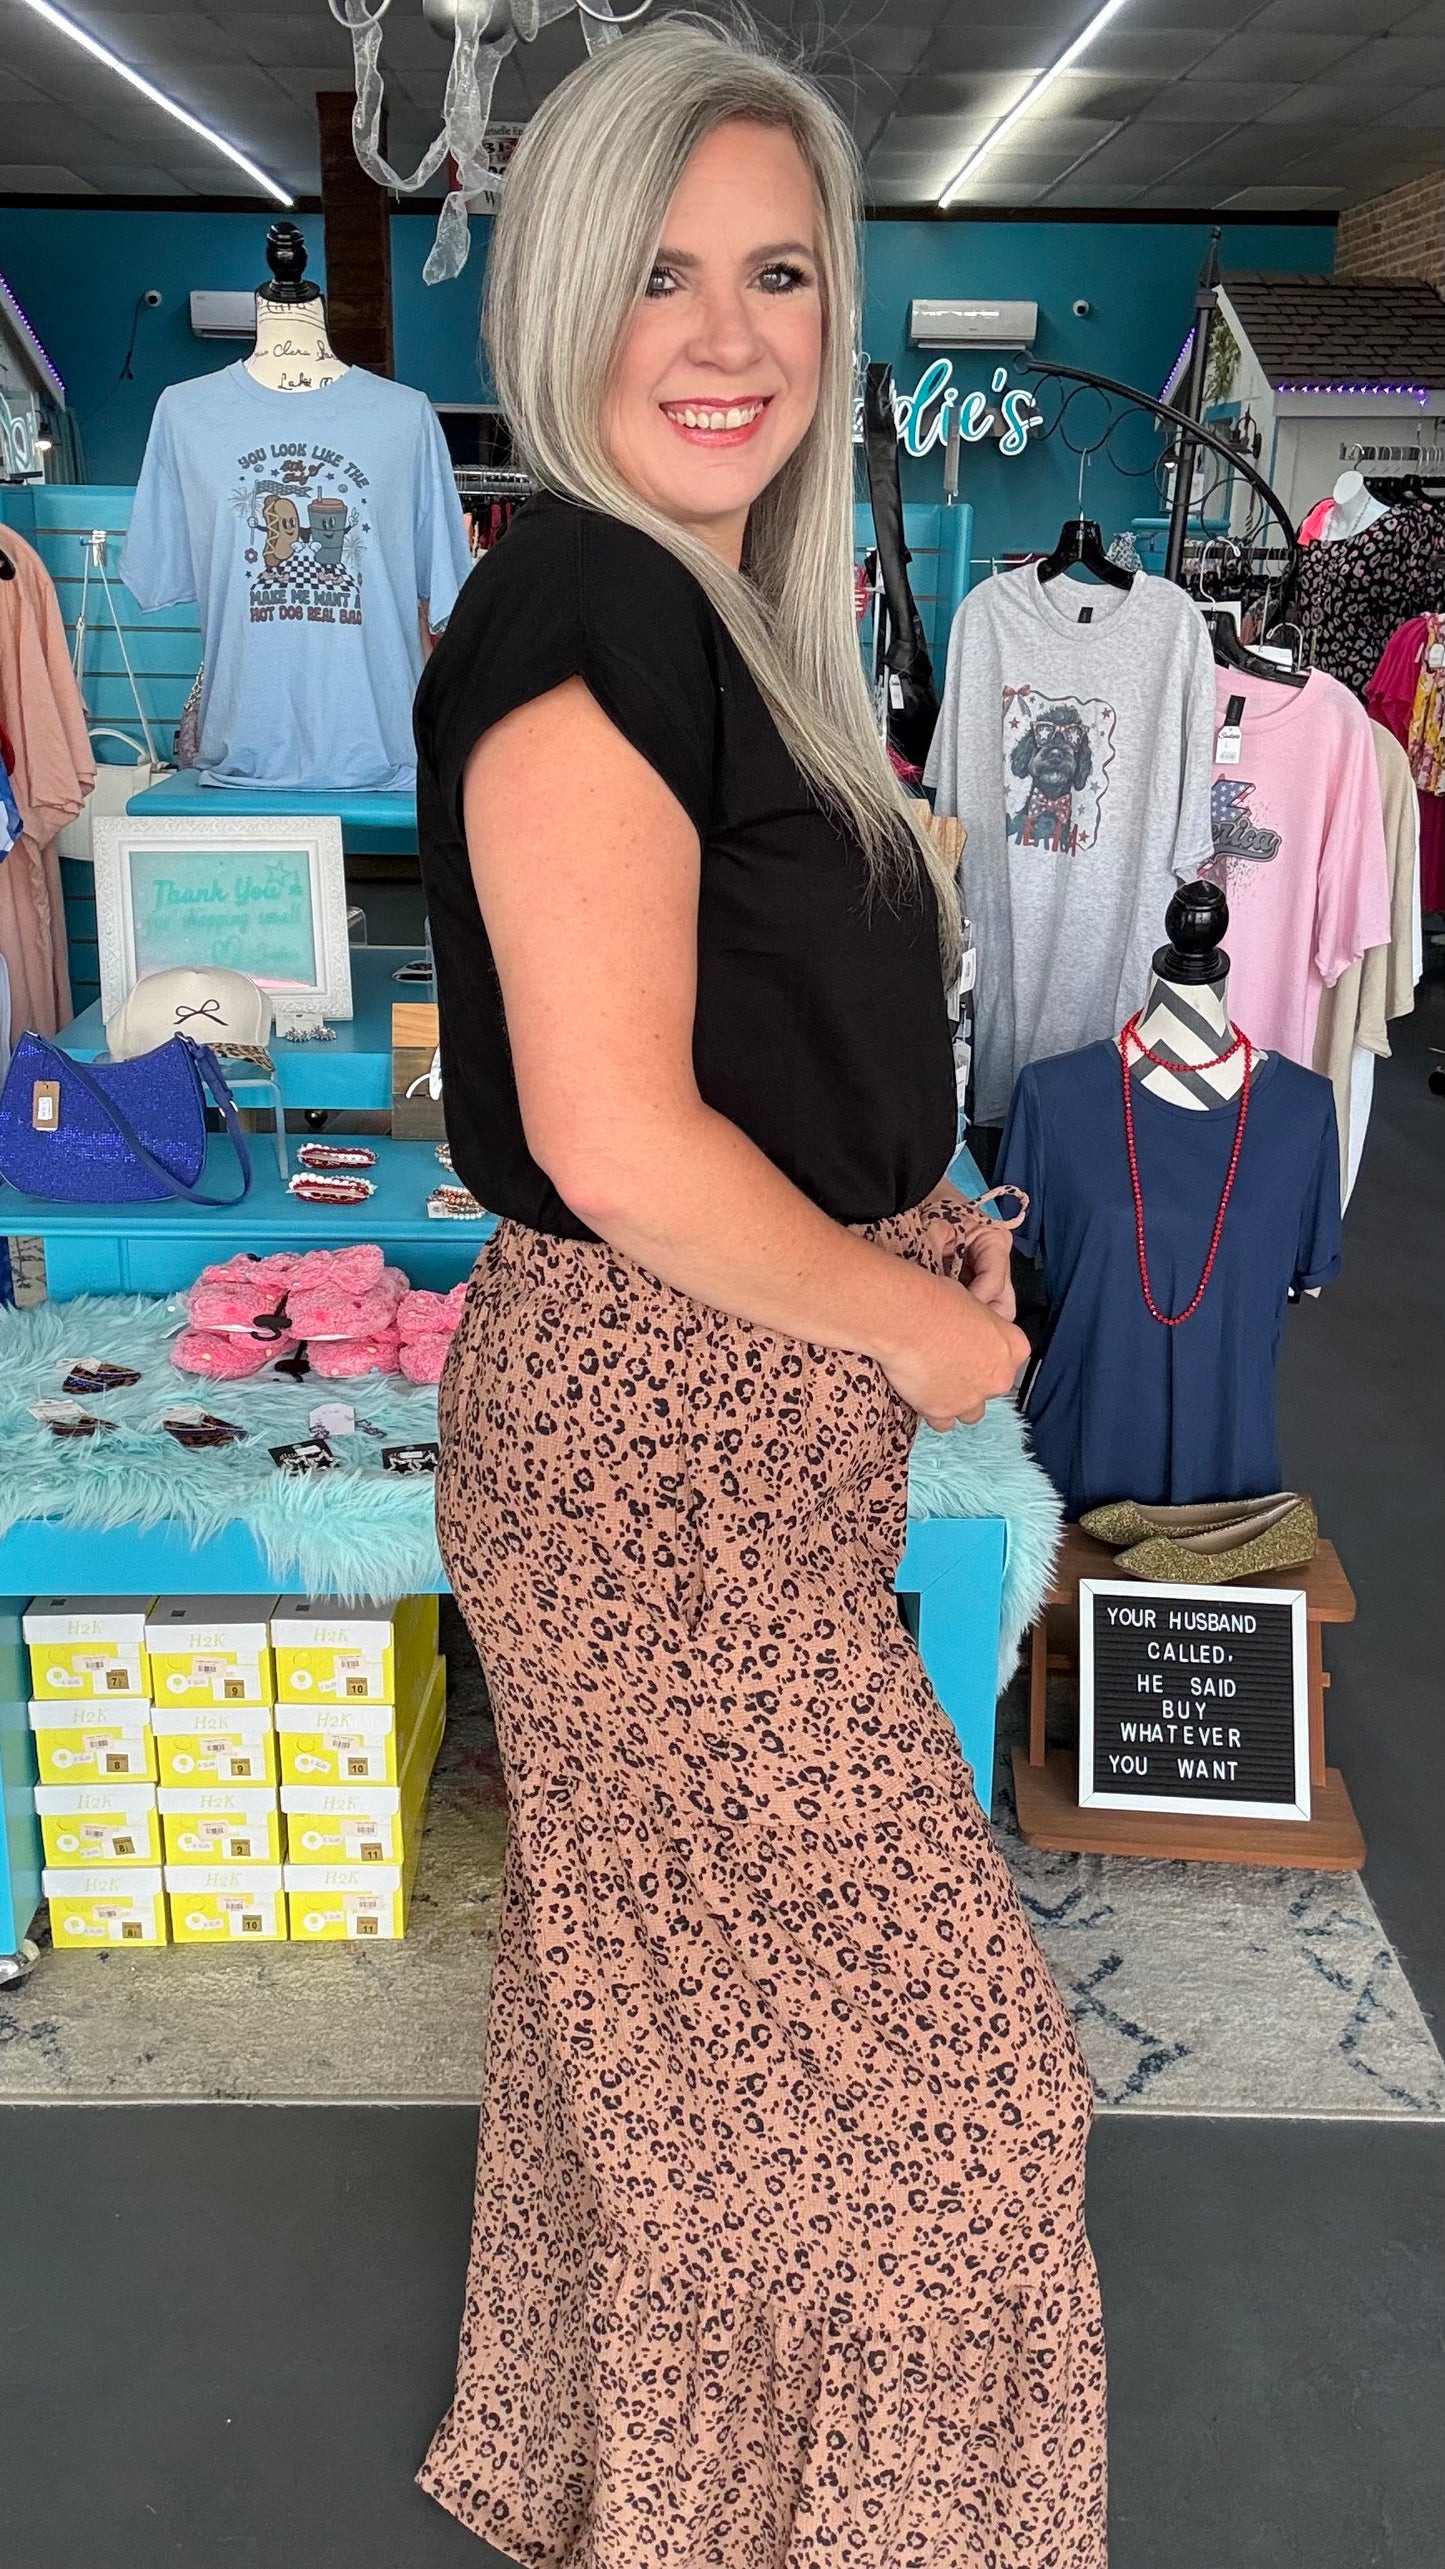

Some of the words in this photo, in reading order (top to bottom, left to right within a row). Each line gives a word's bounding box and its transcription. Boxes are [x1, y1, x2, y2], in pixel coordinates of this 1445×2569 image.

[854, 358, 1044, 457] die's
[237, 447, 267, 470] YOU
[270, 443, 307, 458] LOOK
[311, 445, 344, 468] LIKE
[343, 462, 370, 489] THE
[249, 590, 288, 606] MAKE
[290, 589, 311, 605] ME
[314, 591, 351, 608] WANT
[250, 606, 275, 623] HOT
[279, 605, 304, 620] DOG
[307, 606, 336, 623] REAL
[1212, 819, 1277, 852] erica
[152, 878, 229, 912] Thank
[233, 876, 282, 906] You
[1106, 1607, 1157, 1629] YOUR
[1169, 1611, 1257, 1634] HUSBAND
[1147, 1642, 1233, 1664] CALLED,
[231, 1686, 238, 1696] 9
[352, 1685, 363, 1694] 10
[1137, 1673, 1164, 1693] HE
[1190, 1677, 1237, 1698] SAID
[1162, 1700, 1206, 1720] BUY
[1120, 1722, 1241, 1748] WHATEVER
[237, 1765, 243, 1774] 9
[352, 1765, 363, 1773] 10
[1108, 1754, 1148, 1776] YOU
[1177, 1758, 1238, 1781] WANT
[368, 1850, 378, 1859] 11
[246, 1921, 258, 1930] 10
[362, 1925, 373, 1934] 11
